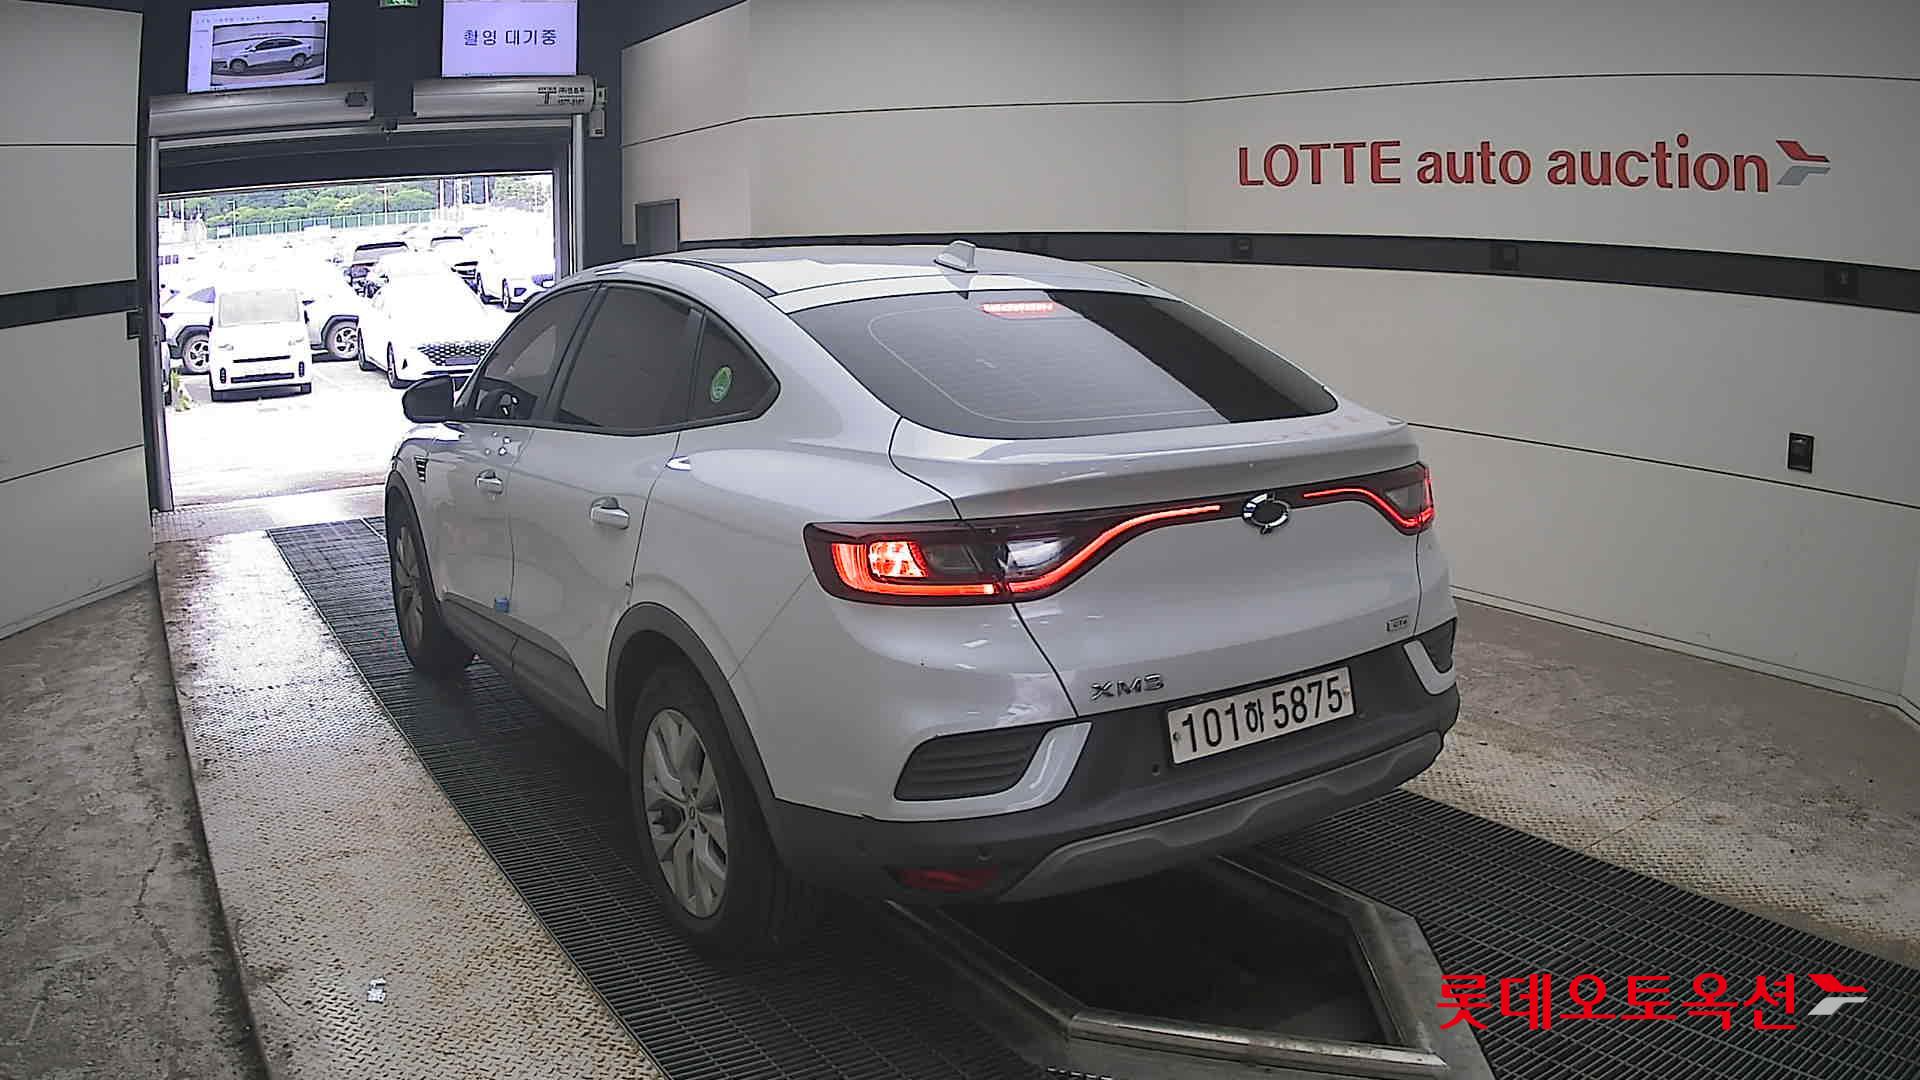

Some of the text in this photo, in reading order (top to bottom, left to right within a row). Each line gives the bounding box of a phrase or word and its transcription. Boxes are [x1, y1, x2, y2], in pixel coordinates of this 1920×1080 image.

[505, 29, 557, 46] 대기중
[1239, 134, 1770, 194] LOTTE auto auction
[1091, 673, 1165, 700] XM3
